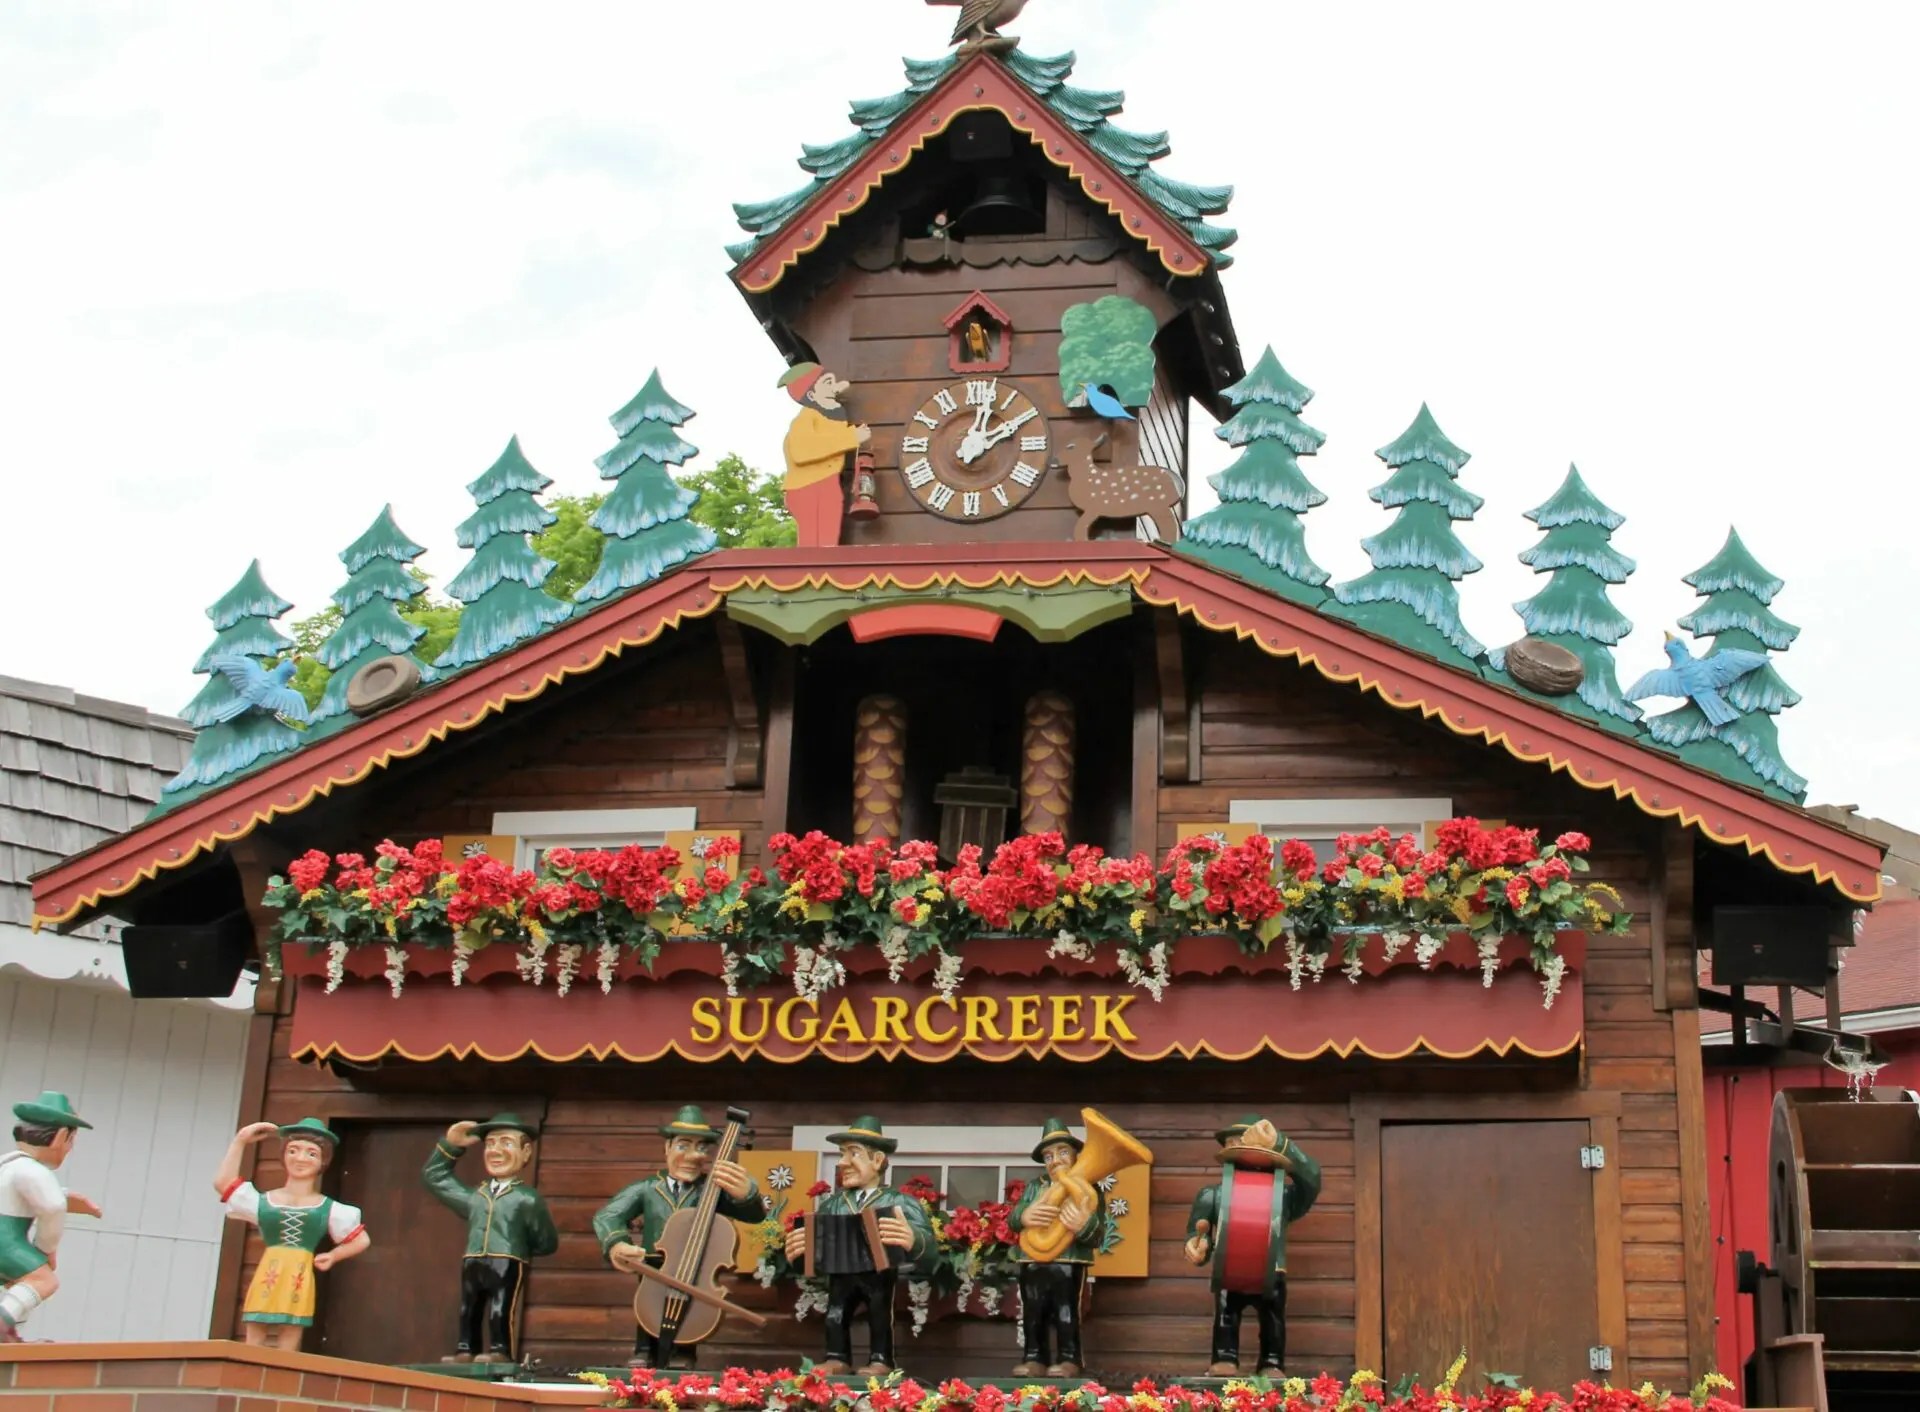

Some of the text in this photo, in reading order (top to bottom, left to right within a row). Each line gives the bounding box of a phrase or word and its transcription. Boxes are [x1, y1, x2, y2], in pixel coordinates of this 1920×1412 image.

[933, 389, 958, 416] XI
[1000, 390, 1018, 411] I
[914, 411, 939, 430] X
[903, 436, 928, 452] IX
[1021, 436, 1047, 451] III
[905, 457, 935, 489] VIII
[1010, 461, 1039, 487] IIII
[928, 482, 955, 511] VII
[963, 491, 980, 516] VI
[991, 483, 1008, 507] V
[690, 994, 1138, 1045] SUGARCREEK
